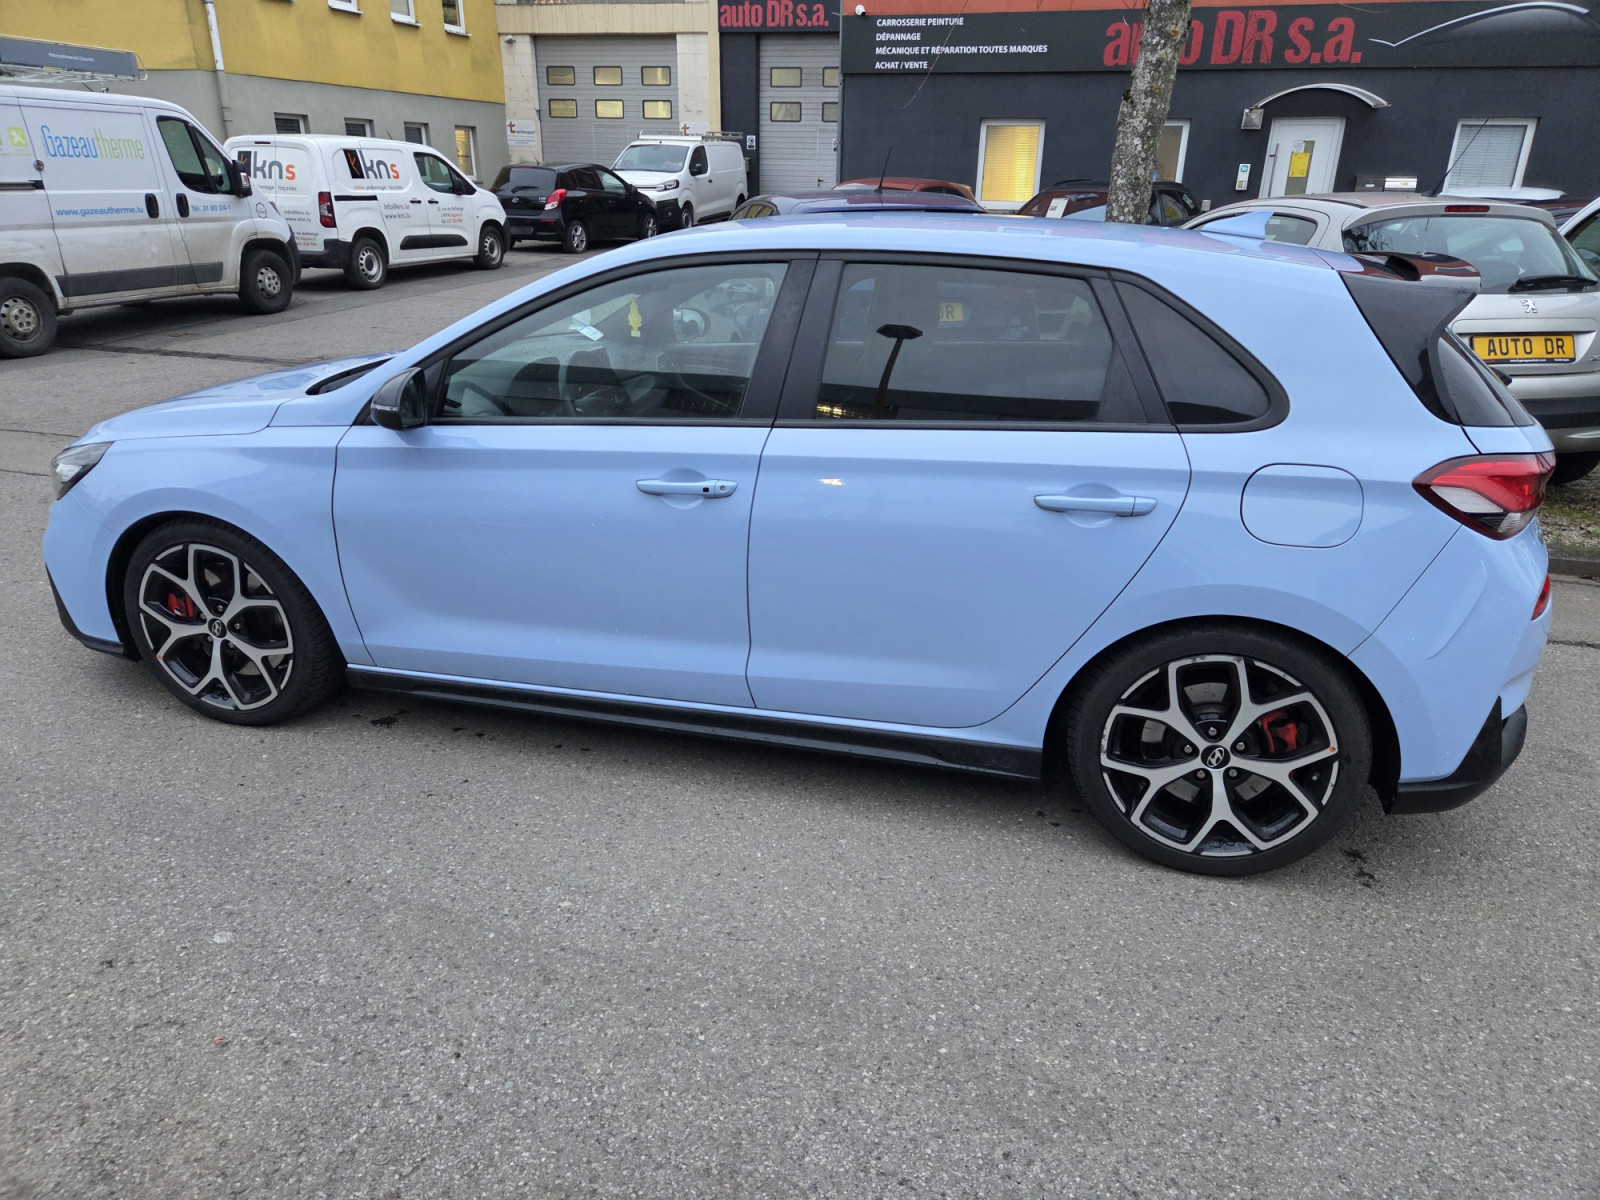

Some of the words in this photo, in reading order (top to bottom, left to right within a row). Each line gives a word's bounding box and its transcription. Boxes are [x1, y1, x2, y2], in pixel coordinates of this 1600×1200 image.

[720, 1, 763, 27] auto
[766, 0, 793, 27] DR
[796, 3, 829, 27] s.a.
[876, 18, 927, 27] CARROSSERIE
[927, 17, 964, 26] PEINTURE
[876, 32, 921, 41] DÉPANNAGE
[1103, 19, 1204, 67] ao
[1210, 10, 1278, 65] DR
[1284, 16, 1362, 65] s.a.
[875, 46, 920, 55] MÉCANIQUE
[921, 46, 930, 55] ET
[931, 45, 978, 55] RÉPARATION
[979, 45, 1008, 54] TOUTES
[1009, 44, 1048, 54] MARQUES
[875, 61, 899, 70] ACHAT
[900, 61, 904, 70] /
[904, 61, 928, 70] VENTE
[41, 124, 145, 160] Gazeautherme
[253, 151, 296, 180] kns
[358, 150, 400, 180] kns
[1487, 338, 1533, 356] AUTO
[1544, 337, 1566, 355] DR
